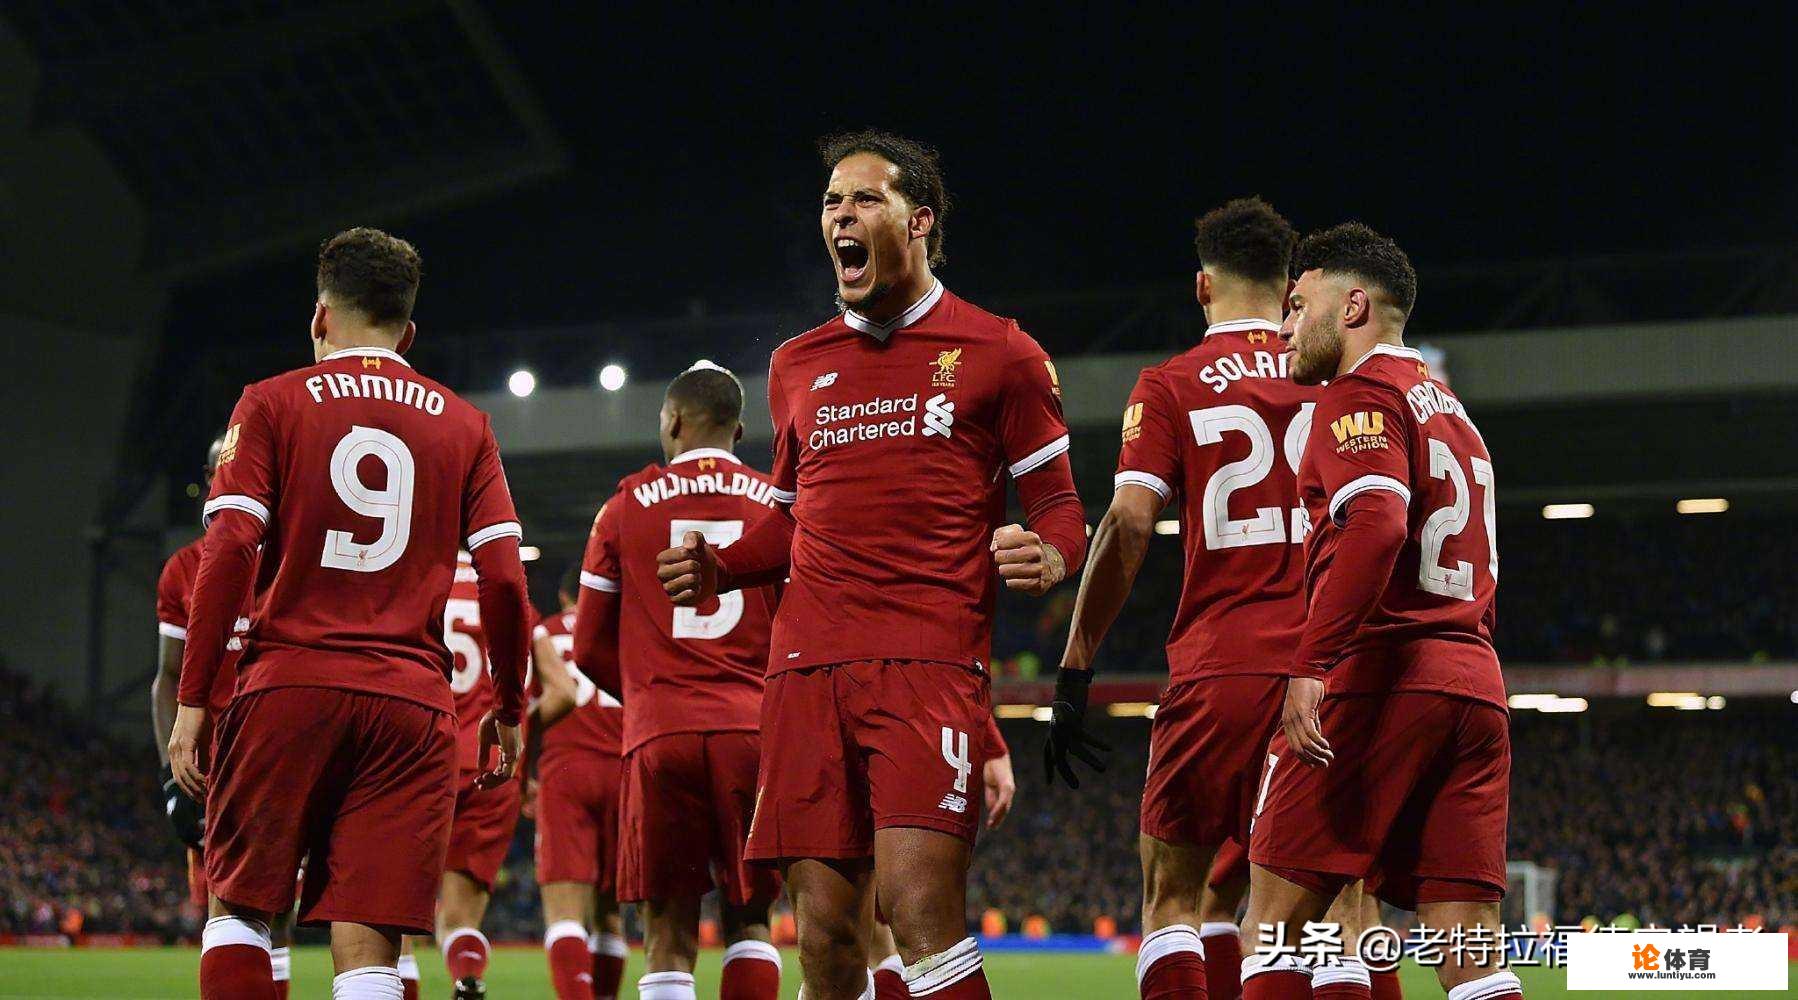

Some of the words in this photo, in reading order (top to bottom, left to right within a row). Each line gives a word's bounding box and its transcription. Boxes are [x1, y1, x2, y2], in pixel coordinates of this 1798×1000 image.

[305, 373, 445, 416] FIRMINO
[815, 393, 918, 425] Standard
[809, 416, 916, 450] Chartered
[1330, 411, 1384, 444] WU
[1336, 435, 1387, 454] WESTERN
[1351, 441, 1389, 453] UNION
[320, 424, 415, 573] 9
[1418, 438, 1498, 601] 21
[941, 726, 972, 794] 4
